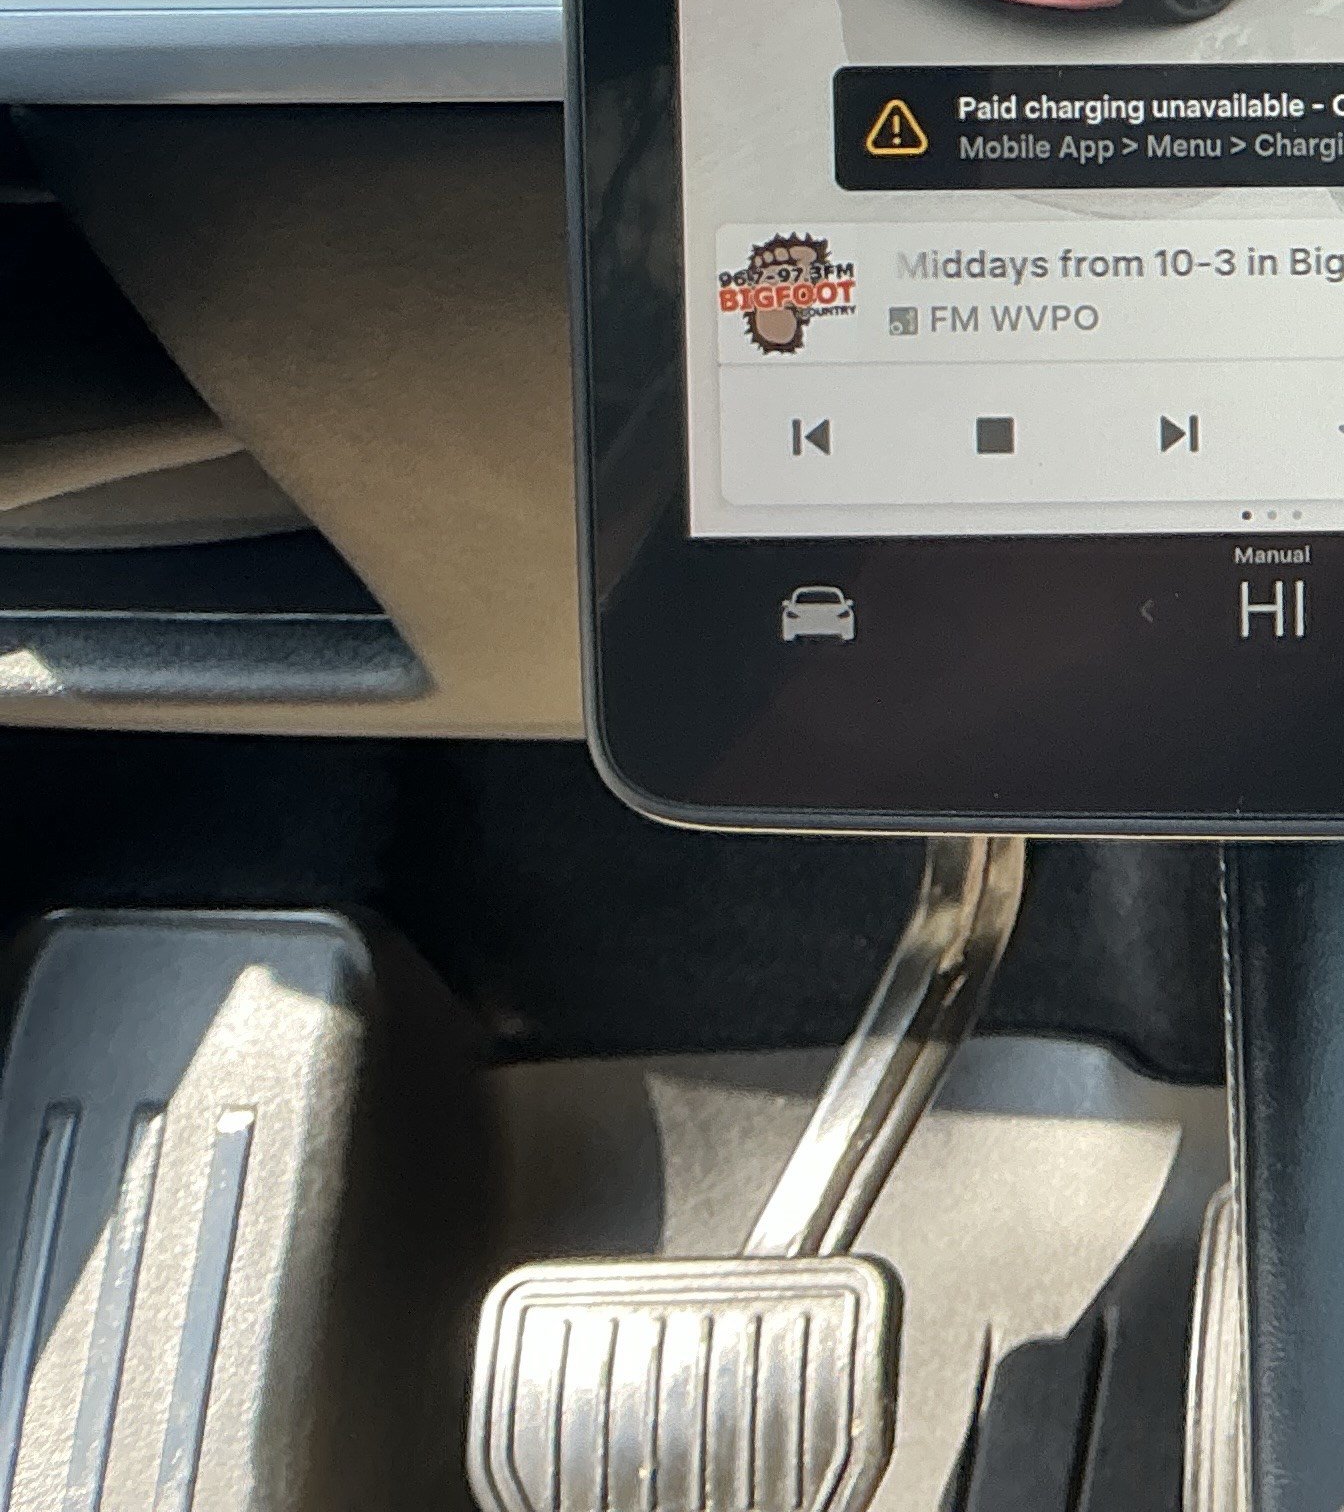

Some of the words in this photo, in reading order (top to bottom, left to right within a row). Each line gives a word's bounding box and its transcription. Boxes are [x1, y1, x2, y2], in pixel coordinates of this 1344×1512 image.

[958, 94, 1017, 120] Paid
[1024, 93, 1145, 125] charging
[1152, 92, 1305, 119] unavailable
[960, 133, 1051, 161] Mobile
[1058, 135, 1115, 165] App
[1147, 134, 1222, 158] Menu
[893, 248, 1048, 285] Middays
[1059, 248, 1144, 278] from
[1154, 248, 1236, 277] 10-3
[1247, 246, 1278, 276] in
[718, 279, 856, 313] BIGFOOT
[930, 305, 979, 333] FM
[990, 304, 1099, 332] WVPO
[1234, 544, 1311, 564] Manual
[1240, 580, 1305, 638] HI
